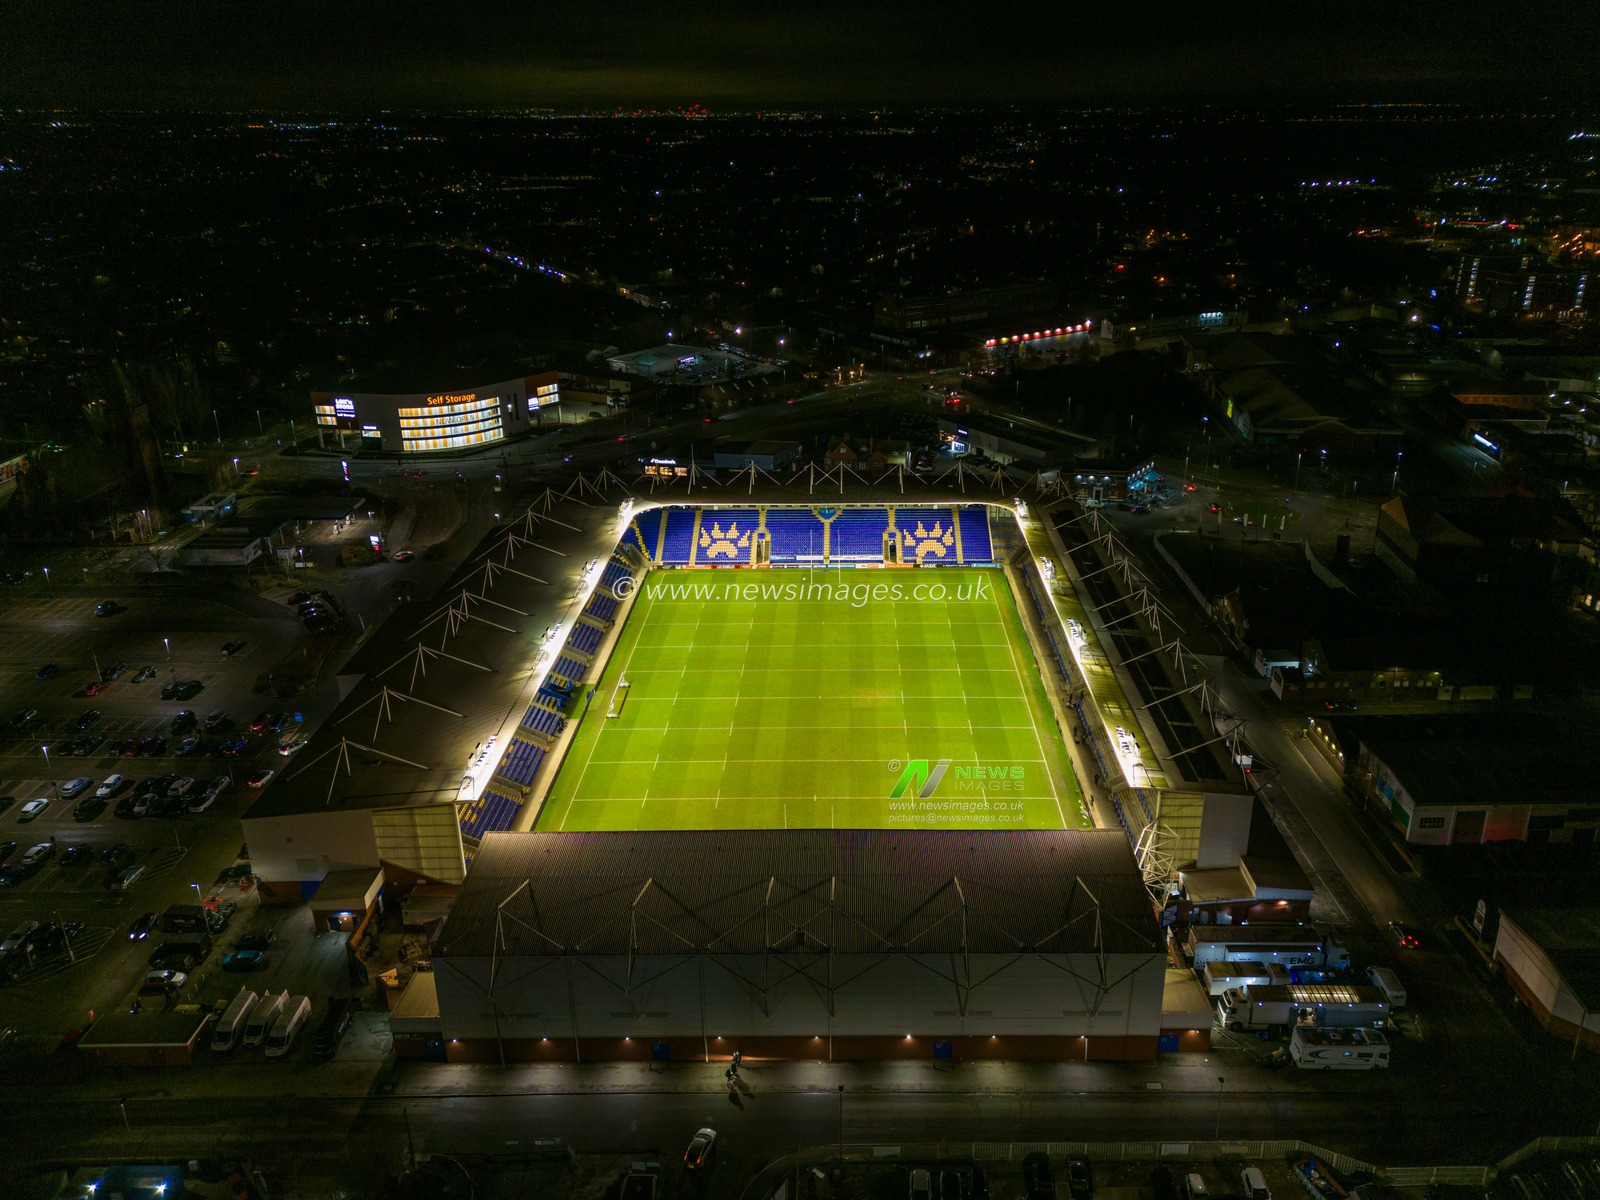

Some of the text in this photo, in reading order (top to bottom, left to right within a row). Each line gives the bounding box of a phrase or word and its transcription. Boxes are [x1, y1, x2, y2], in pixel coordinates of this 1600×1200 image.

[427, 393, 476, 405] Self Storage
[436, 414, 475, 426] NOW OPEN
[1290, 957, 1315, 965] EMG
